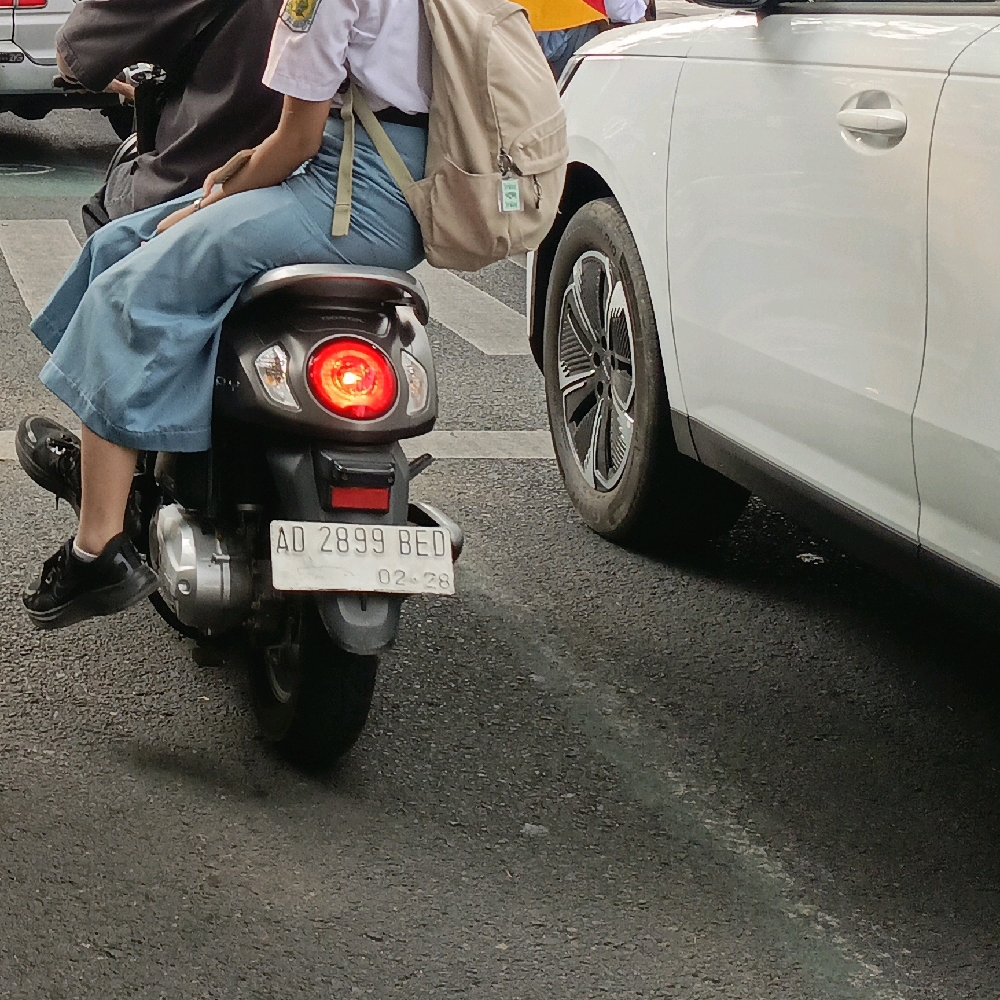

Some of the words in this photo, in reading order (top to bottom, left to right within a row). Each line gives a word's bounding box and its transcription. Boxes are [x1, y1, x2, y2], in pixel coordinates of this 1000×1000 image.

[276, 525, 306, 554] AD
[318, 526, 386, 554] 2899
[397, 528, 446, 557] BED
